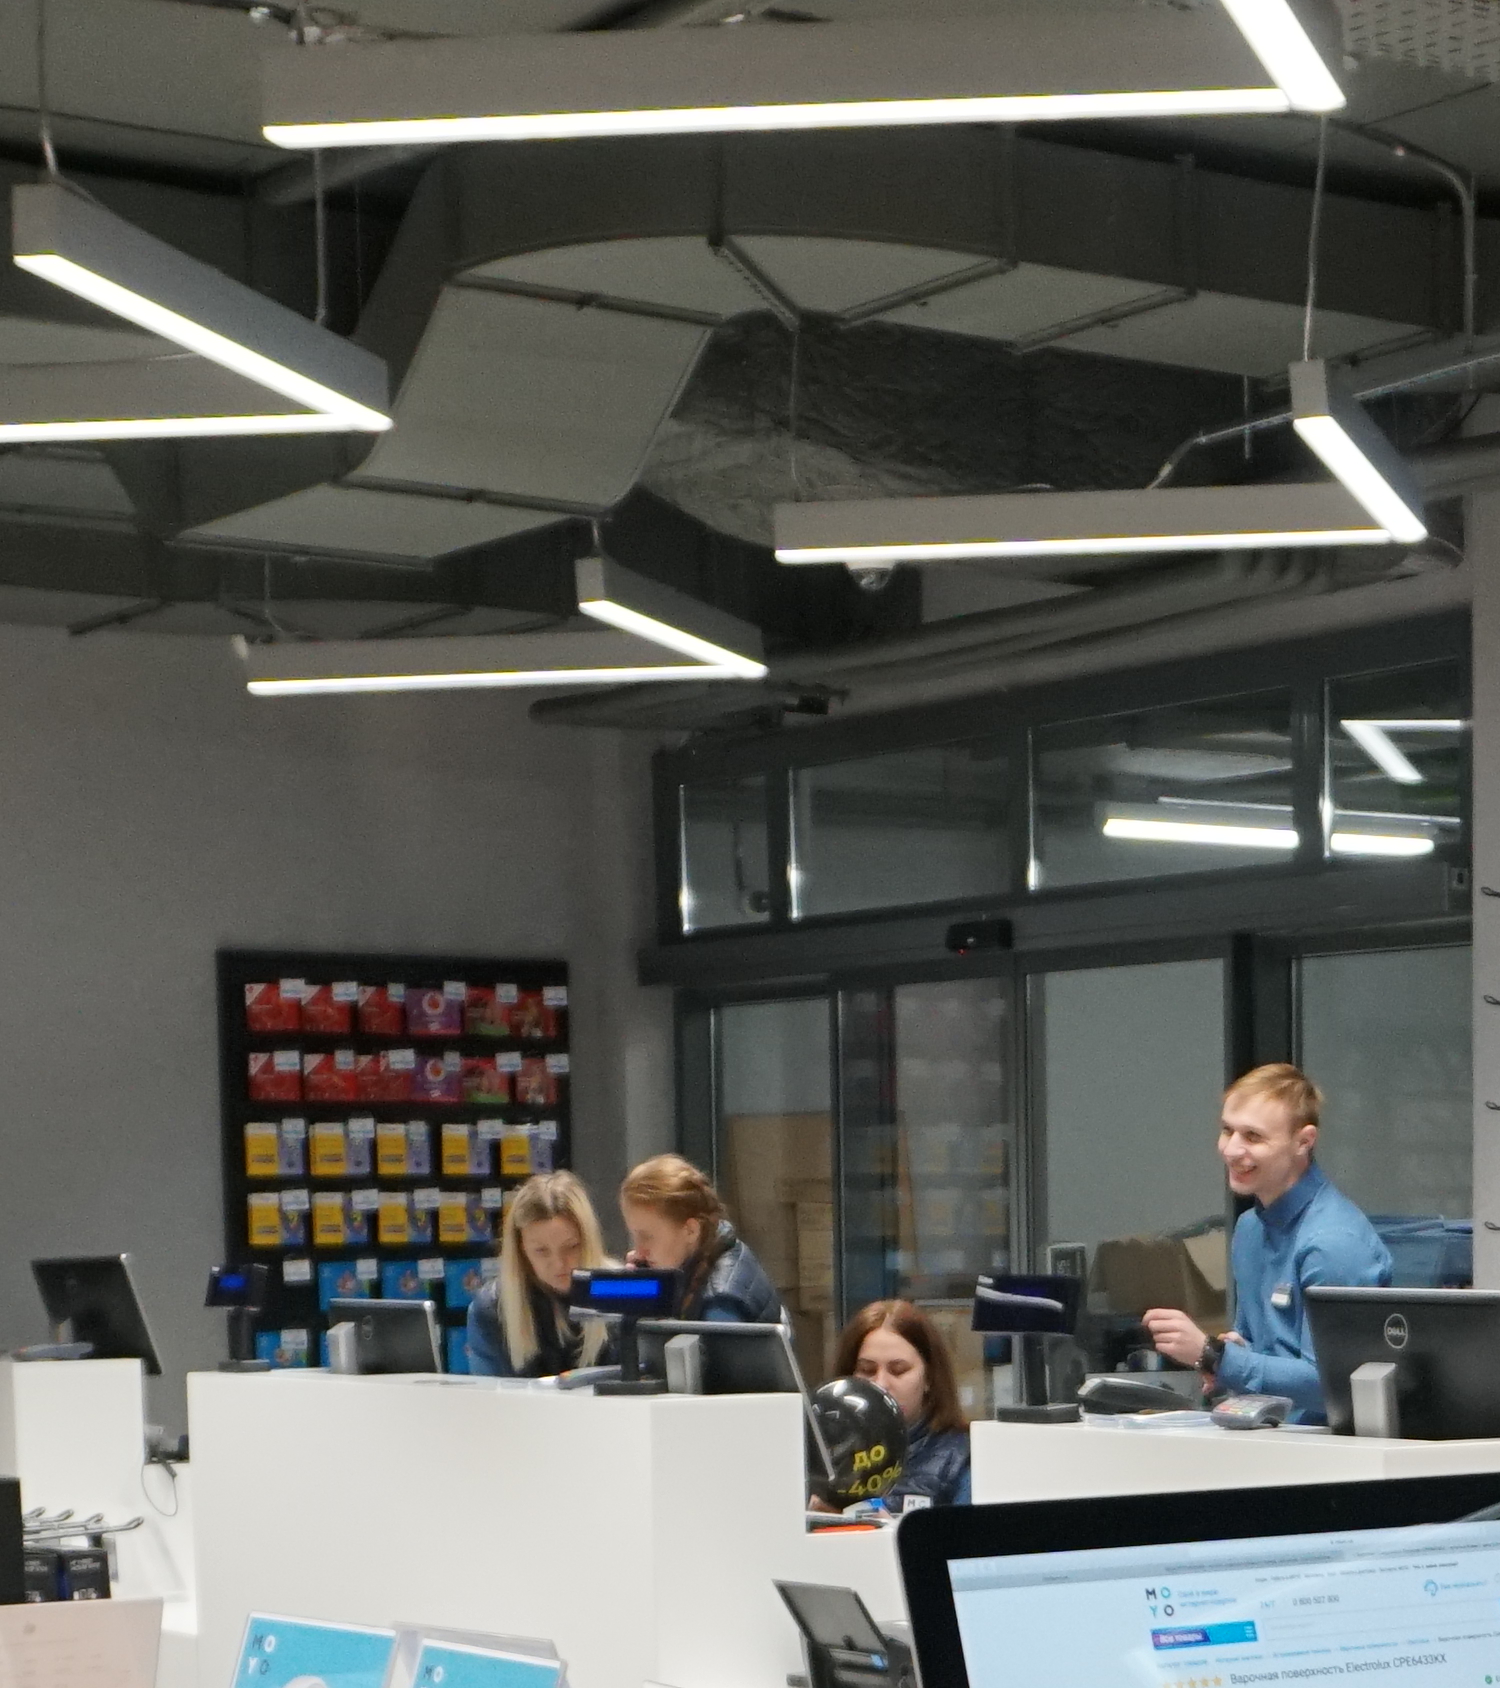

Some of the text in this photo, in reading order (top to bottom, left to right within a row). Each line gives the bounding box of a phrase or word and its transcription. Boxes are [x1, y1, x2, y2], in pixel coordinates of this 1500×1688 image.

[853, 1444, 886, 1471] ДО
[836, 1460, 903, 1496] -40%
[1230, 1670, 1279, 1685] Варочная
[1281, 1664, 1344, 1681] поверхность
[1345, 1660, 1391, 1674] Electrolux
